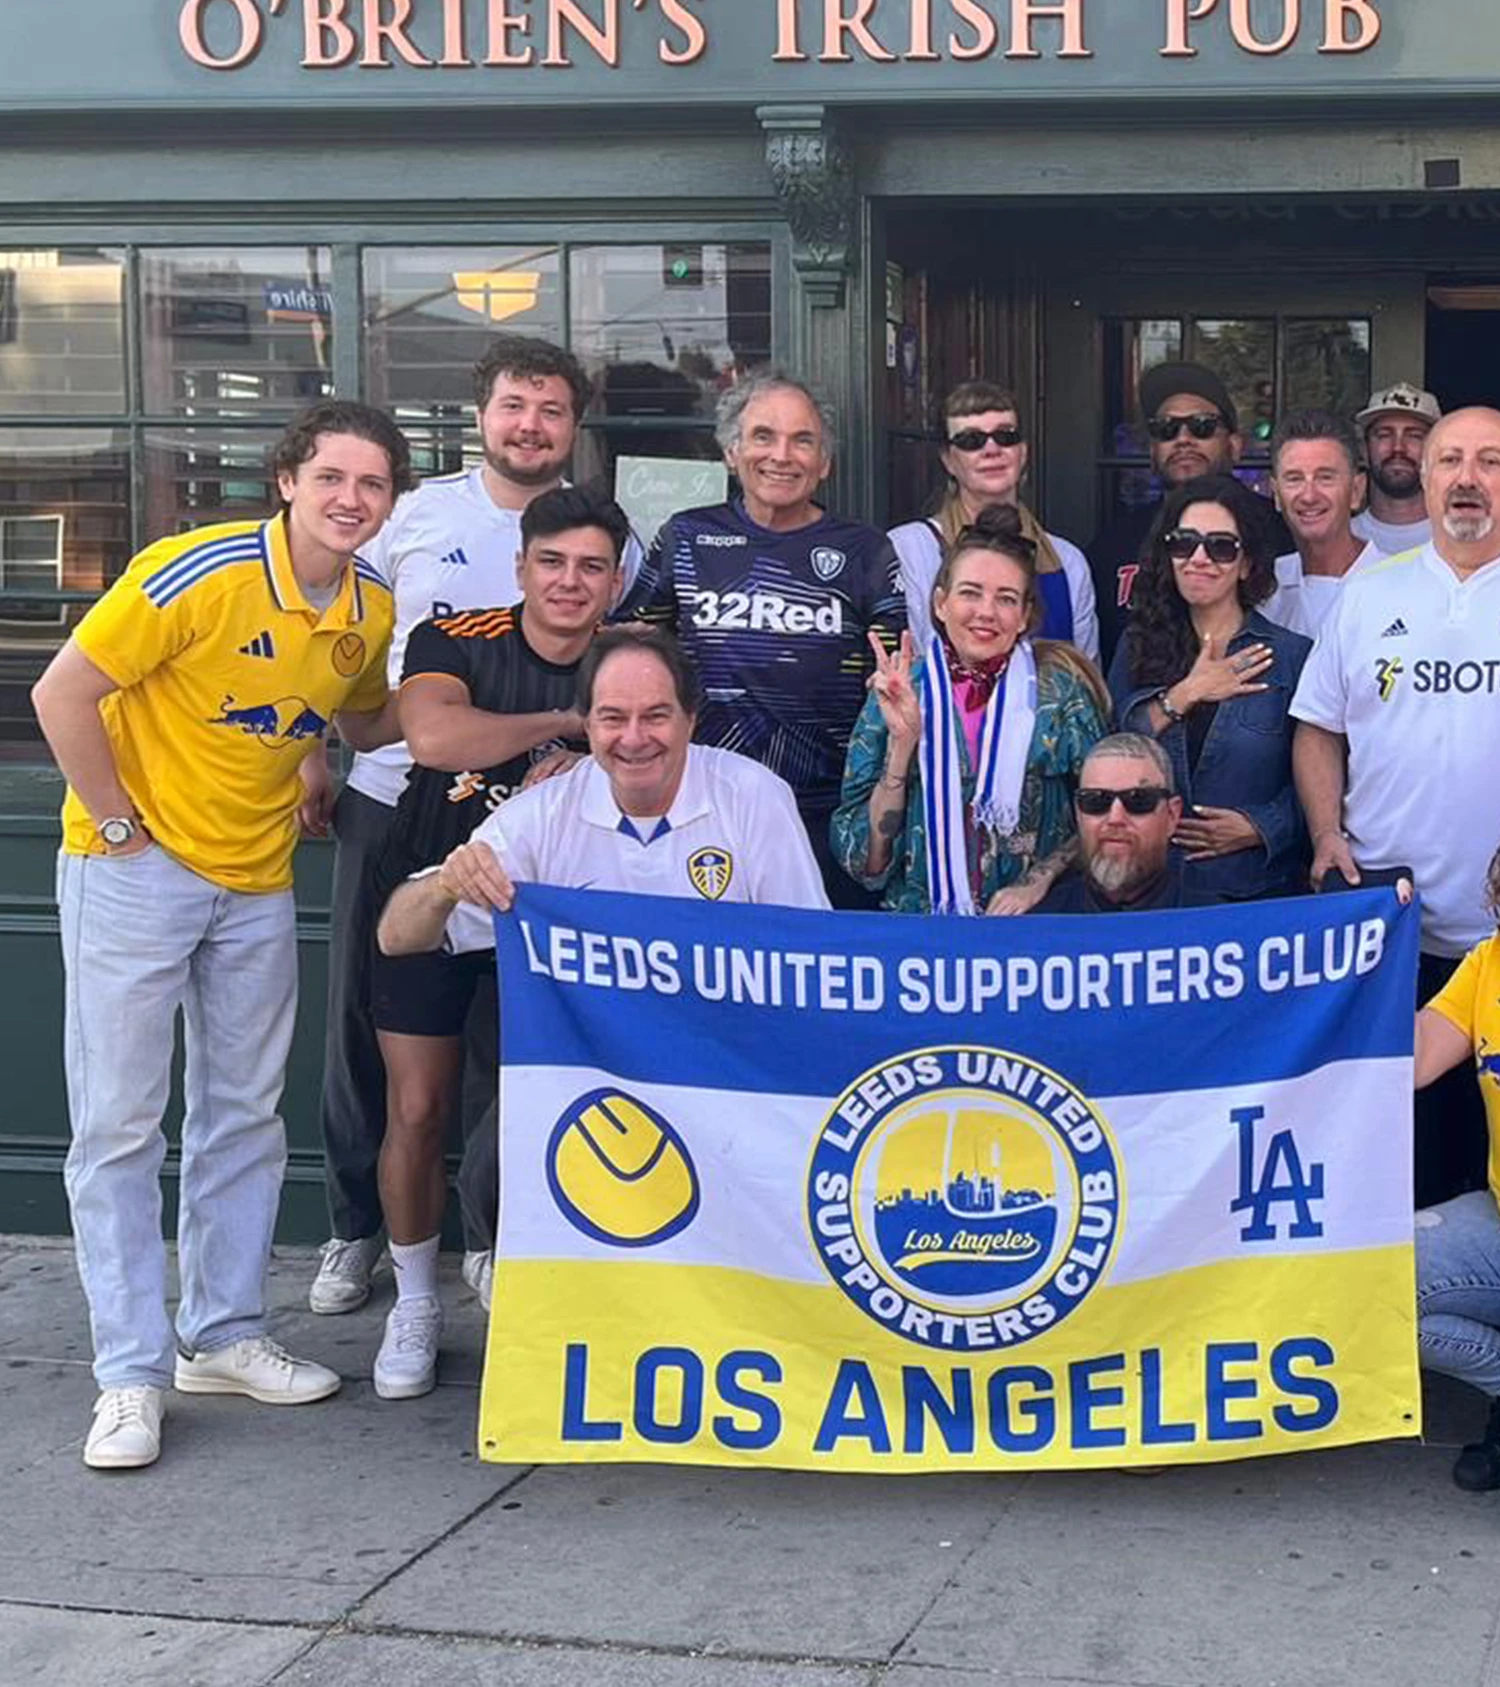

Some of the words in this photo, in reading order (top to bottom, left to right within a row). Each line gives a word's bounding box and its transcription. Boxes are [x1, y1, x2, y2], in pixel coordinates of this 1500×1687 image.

[178, 0, 707, 69] O'BRIEN'S
[770, 0, 1096, 62] IRISH
[1158, 0, 1383, 56] PUB
[692, 591, 842, 634] 32Red
[519, 920, 682, 995] LEEDS
[693, 944, 885, 1012] UNITED
[898, 941, 1245, 1014] SUPPORTERS
[1257, 917, 1386, 993] CLUB
[822, 1054, 943, 1152] LEEDS
[957, 1052, 1103, 1153] UNITED
[1230, 1105, 1324, 1242] LA
[815, 1170, 1056, 1346] SUPPORTERS
[1054, 1170, 1115, 1297] CLUB
[903, 1228, 943, 1250] Los
[950, 1228, 1036, 1253] Angeles
[561, 1343, 783, 1451] LOS
[812, 1336, 1339, 1455] ANGELES
